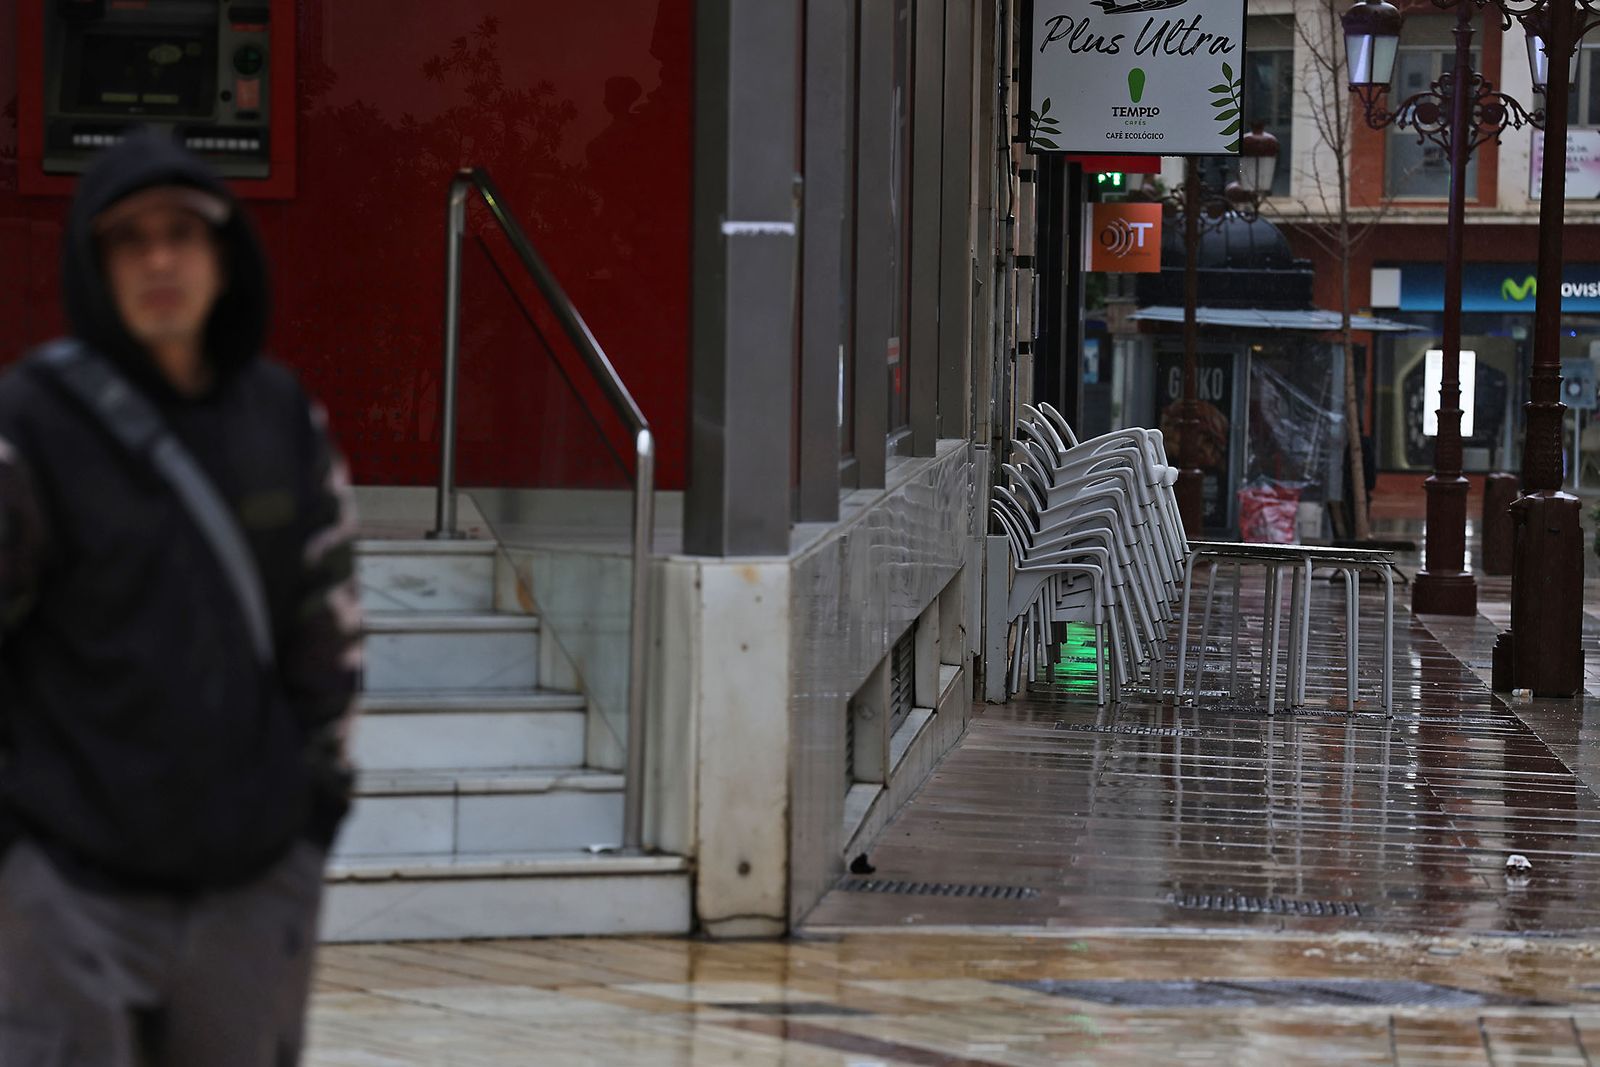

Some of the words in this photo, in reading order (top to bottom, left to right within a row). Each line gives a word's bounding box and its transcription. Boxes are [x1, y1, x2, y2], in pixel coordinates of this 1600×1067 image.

[1039, 14, 1126, 55] Plus
[1133, 14, 1236, 57] Ultra
[1111, 106, 1160, 117] TEMPLO
[1105, 130, 1123, 139] CAFÉ
[1124, 130, 1164, 140] ECOLÓGICO
